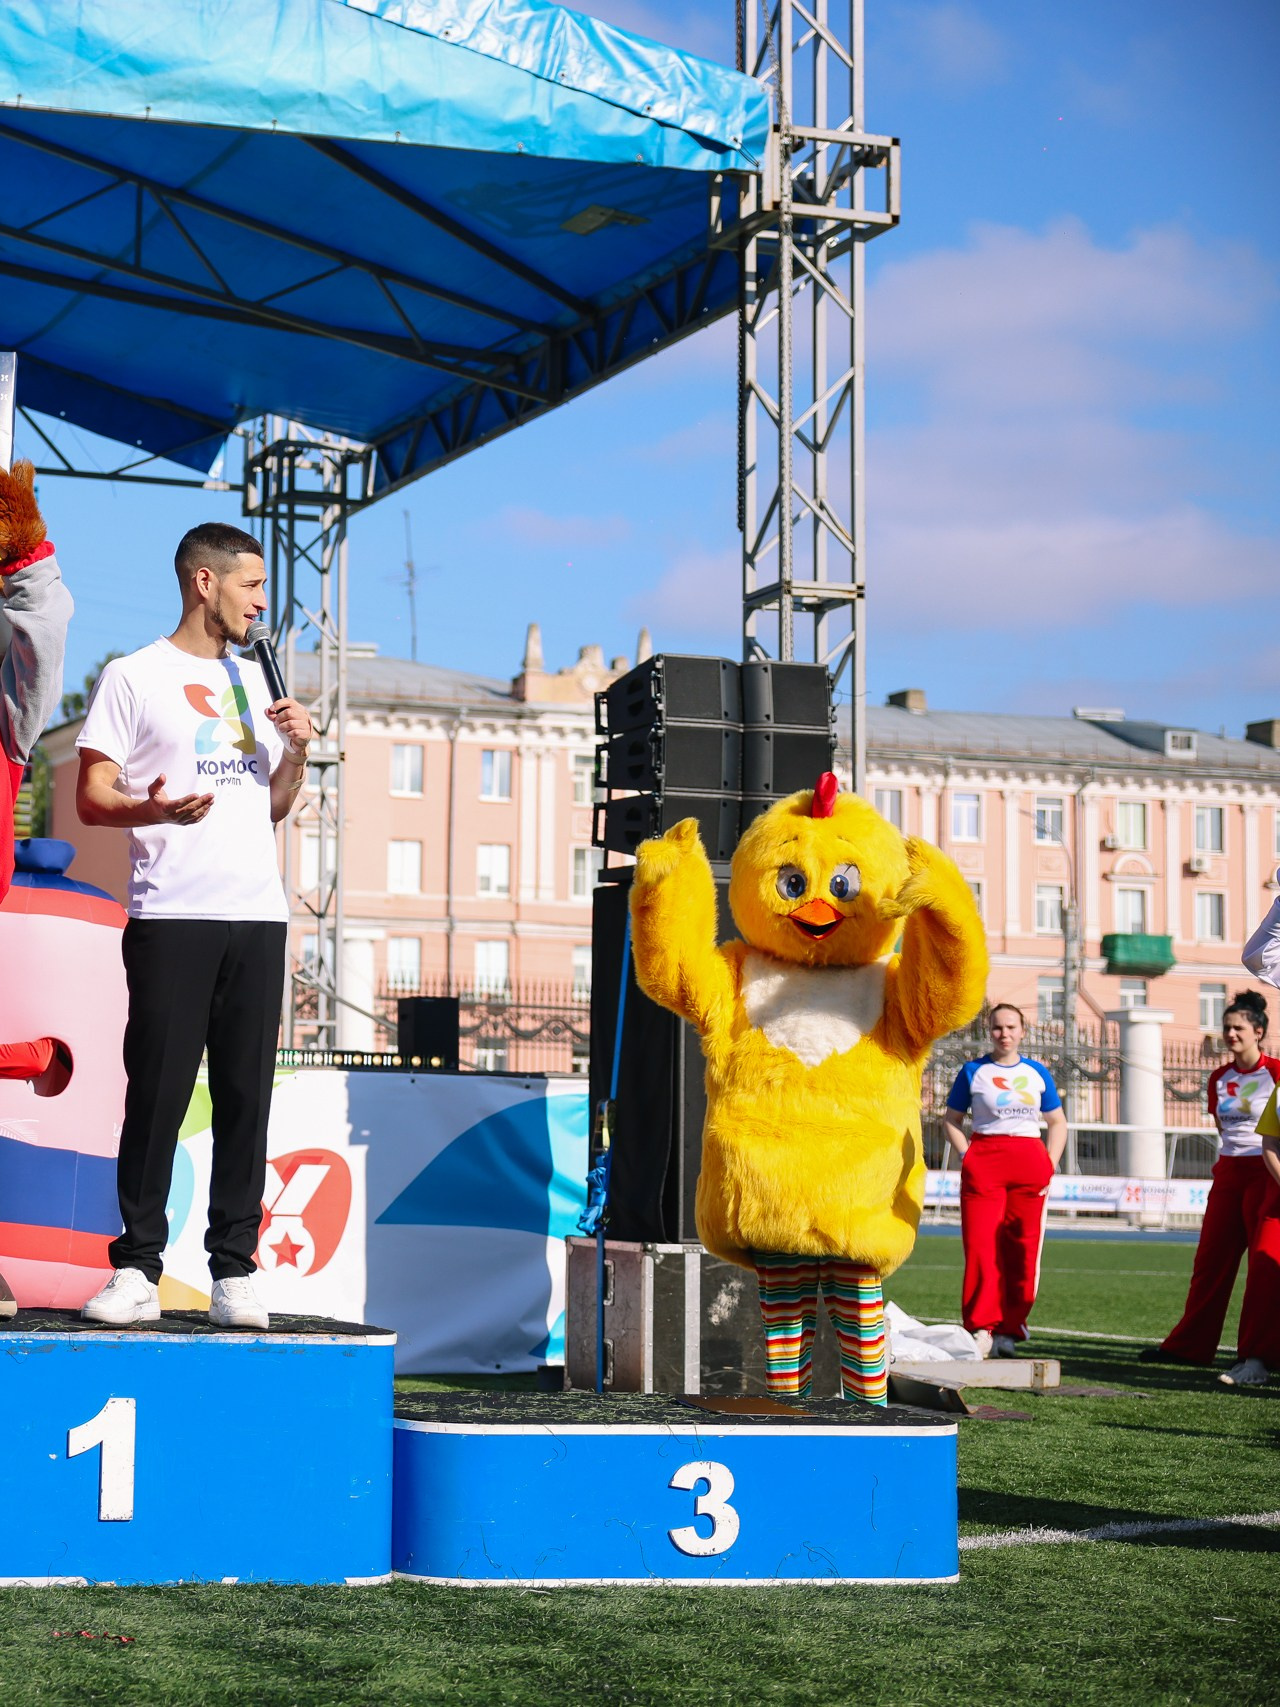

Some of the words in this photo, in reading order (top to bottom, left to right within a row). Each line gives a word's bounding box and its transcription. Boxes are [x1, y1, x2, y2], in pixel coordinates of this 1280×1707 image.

[196, 759, 258, 775] КОМОС
[215, 776, 242, 787] ГРУПП
[67, 1397, 137, 1522] 1
[668, 1460, 740, 1557] 3
